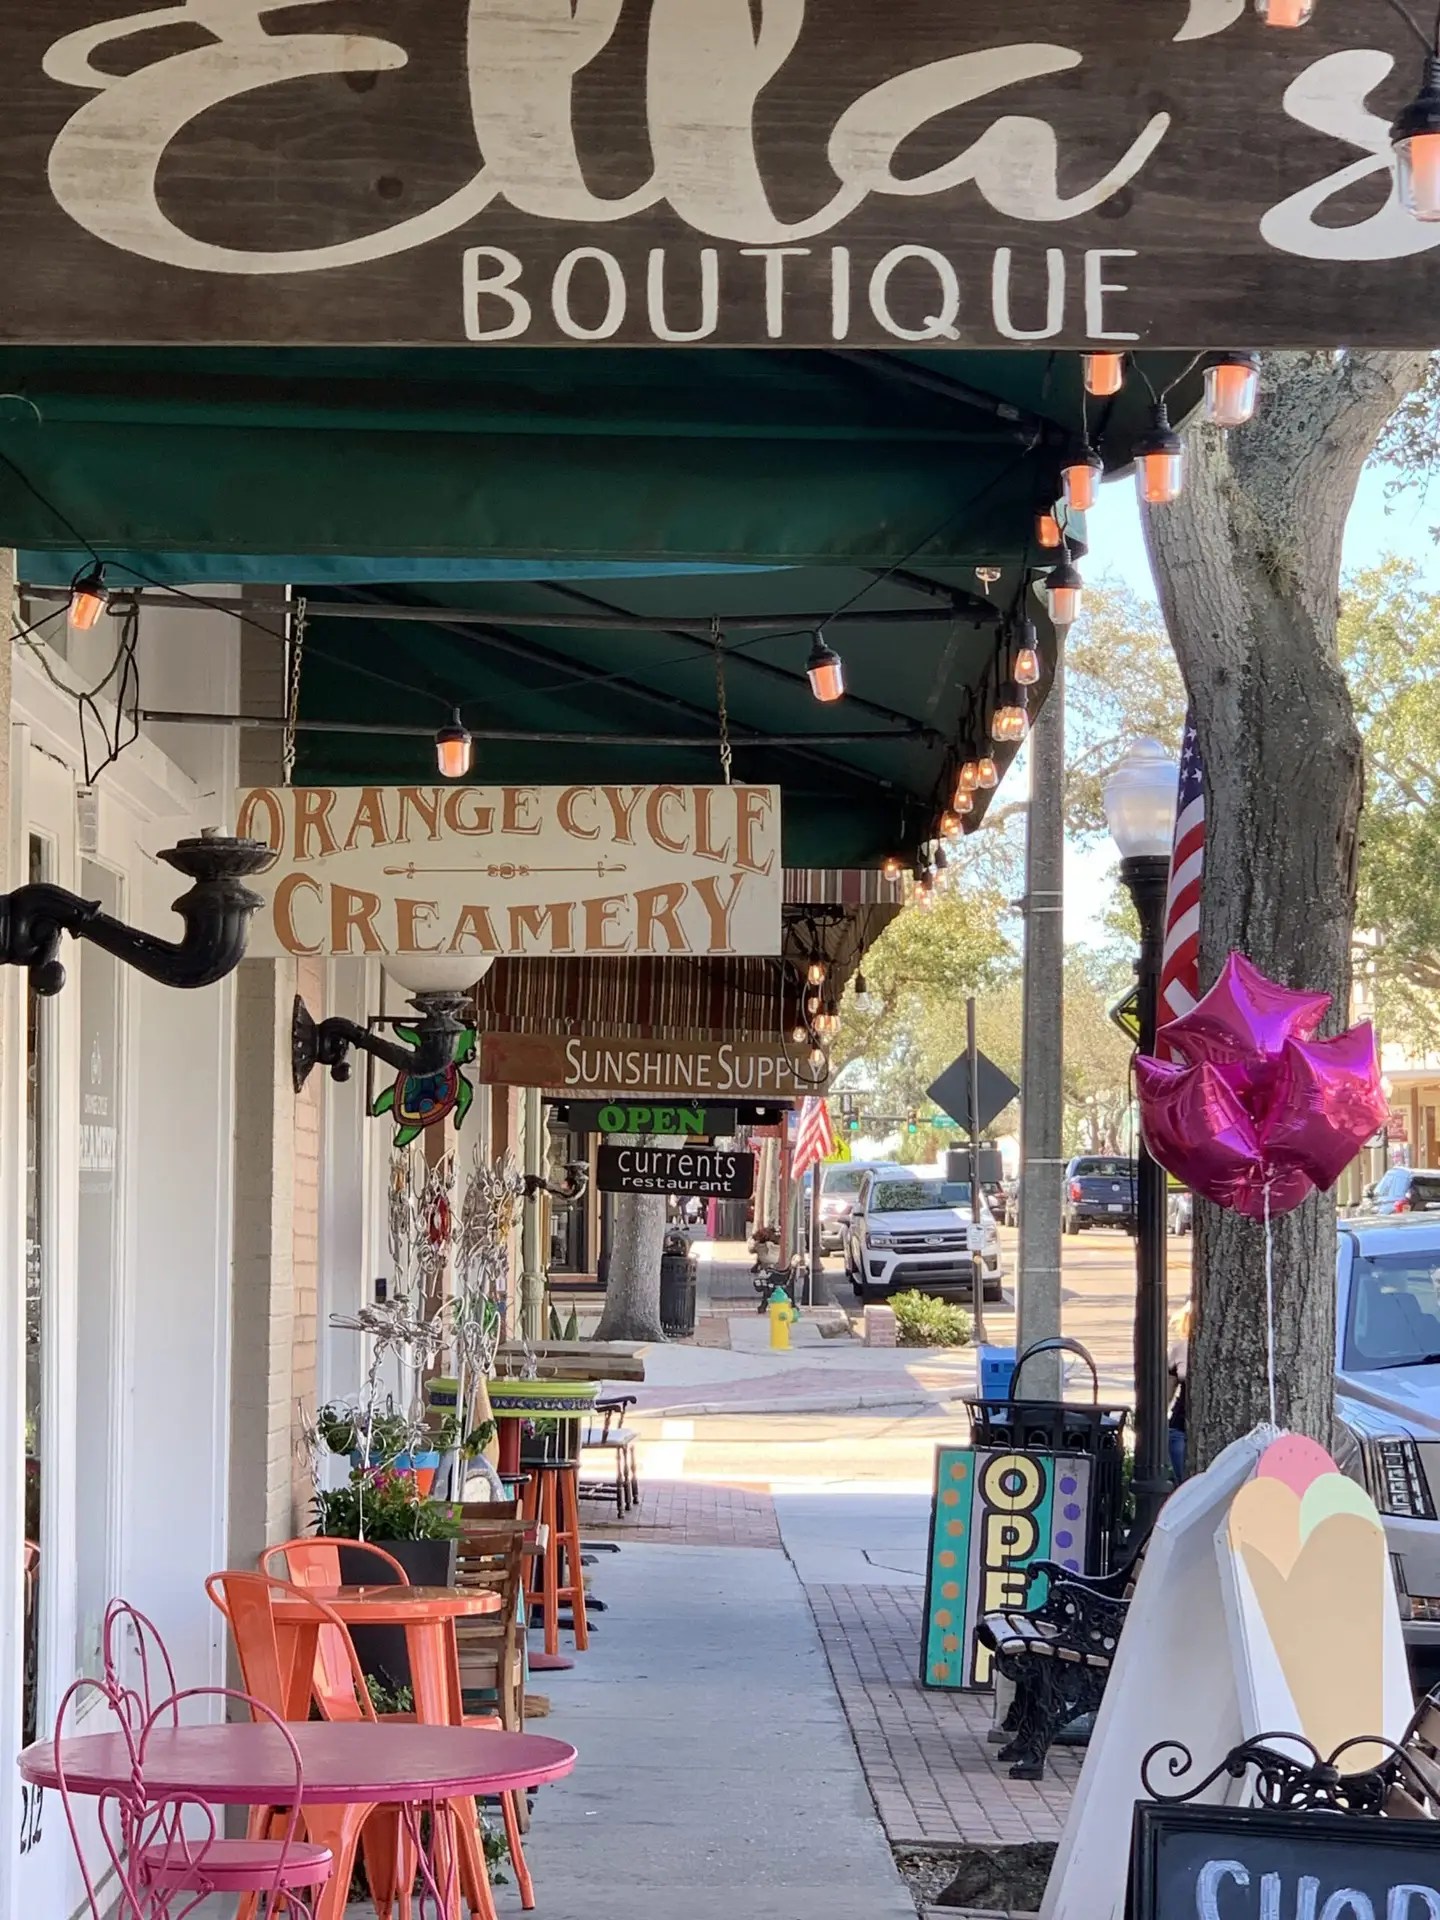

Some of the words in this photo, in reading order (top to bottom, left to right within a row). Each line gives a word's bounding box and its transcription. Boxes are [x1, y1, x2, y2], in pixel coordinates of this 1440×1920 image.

[463, 244, 1140, 342] BOUTIQUE
[236, 787, 542, 875] ORANGE
[556, 785, 775, 876] CYCLE
[273, 872, 748, 955] CREAMERY
[565, 1038, 711, 1088] SUNSHINE
[598, 1105, 707, 1135] OPEN
[618, 1150, 737, 1179] currents
[622, 1176, 732, 1192] restaurant
[970, 1451, 1048, 1690] OPE
